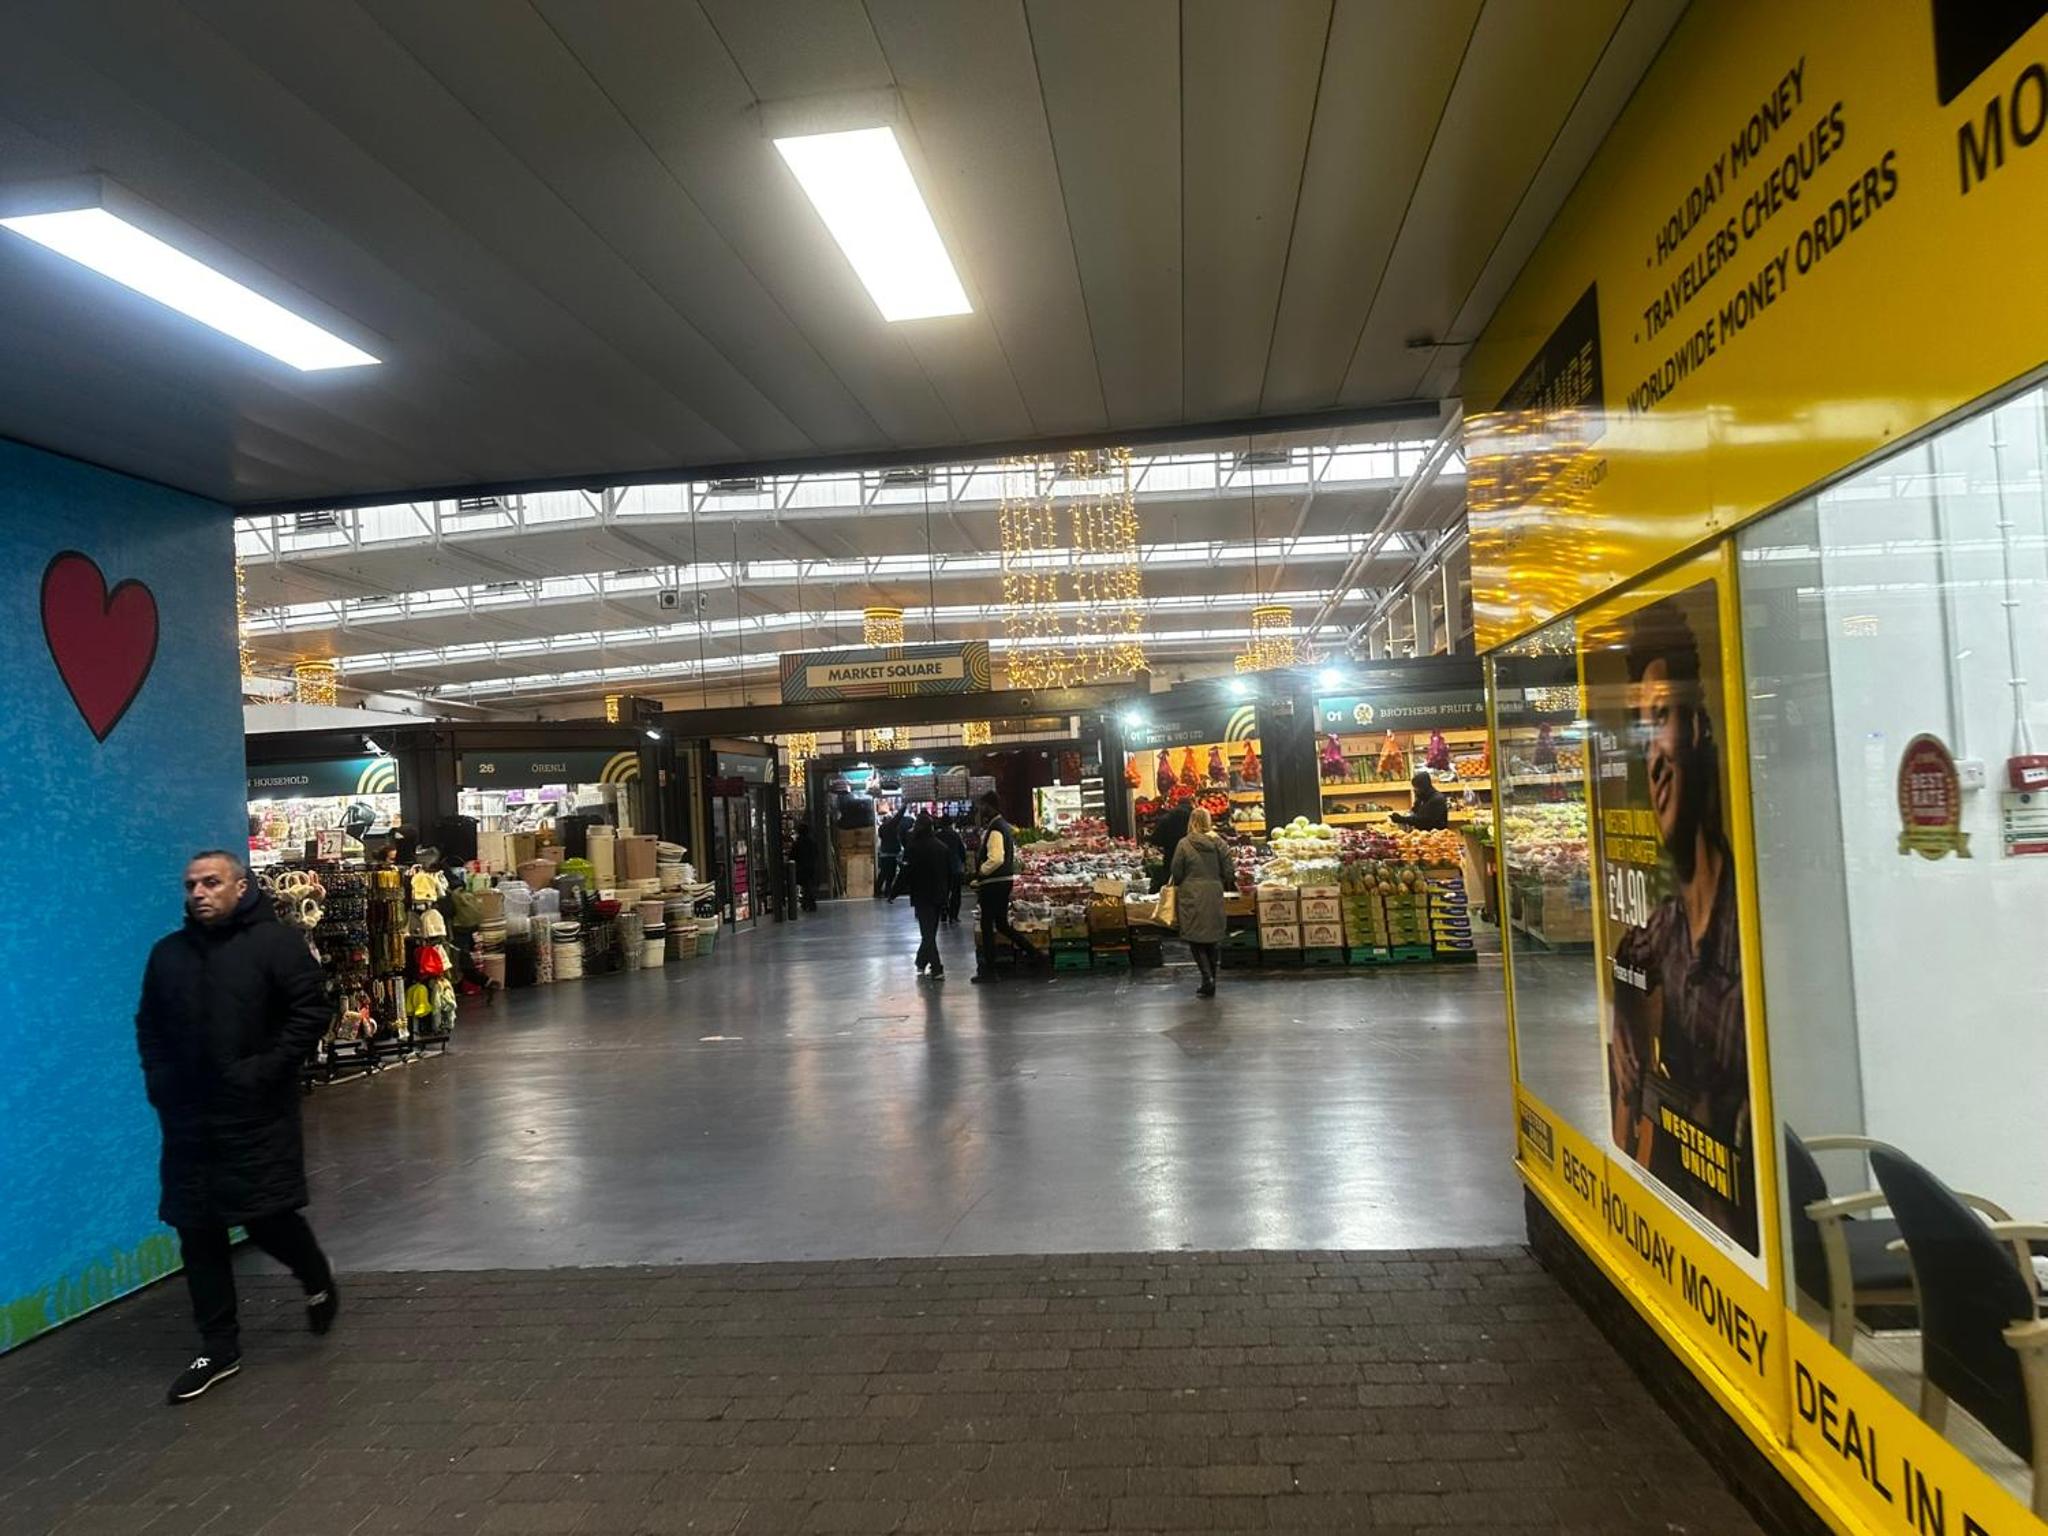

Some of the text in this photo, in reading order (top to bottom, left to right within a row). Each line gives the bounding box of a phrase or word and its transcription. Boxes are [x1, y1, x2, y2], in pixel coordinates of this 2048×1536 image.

[1656, 55, 1806, 266] HOLIDAY MONEY
[1643, 100, 1845, 342] TRAVELLERS CHEQUES
[1627, 317, 1716, 420] WORLDWIDE
[1718, 246, 1789, 345] MONEY
[1795, 150, 1899, 275] ORDERS
[828, 662, 943, 682] MARKET SQUARE
[1326, 710, 1343, 722] 01
[1380, 702, 1437, 718] BROTHERS
[1440, 702, 1472, 715] FRUIT
[1474, 702, 1484, 713] &
[253, 775, 309, 788] HOUSEHOLD
[479, 763, 496, 774] 26
[1608, 867, 1648, 929] £4.90
[1661, 1105, 1728, 1171] WESTERN
[1680, 1143, 1728, 1198] UNION
[1563, 1146, 1597, 1208] BEST
[1601, 1180, 1675, 1285] HOLIDAY
[1681, 1255, 1768, 1377] MONEY
[1795, 1359, 1893, 1503] DEAL
[1902, 1457, 1946, 1536] IN
